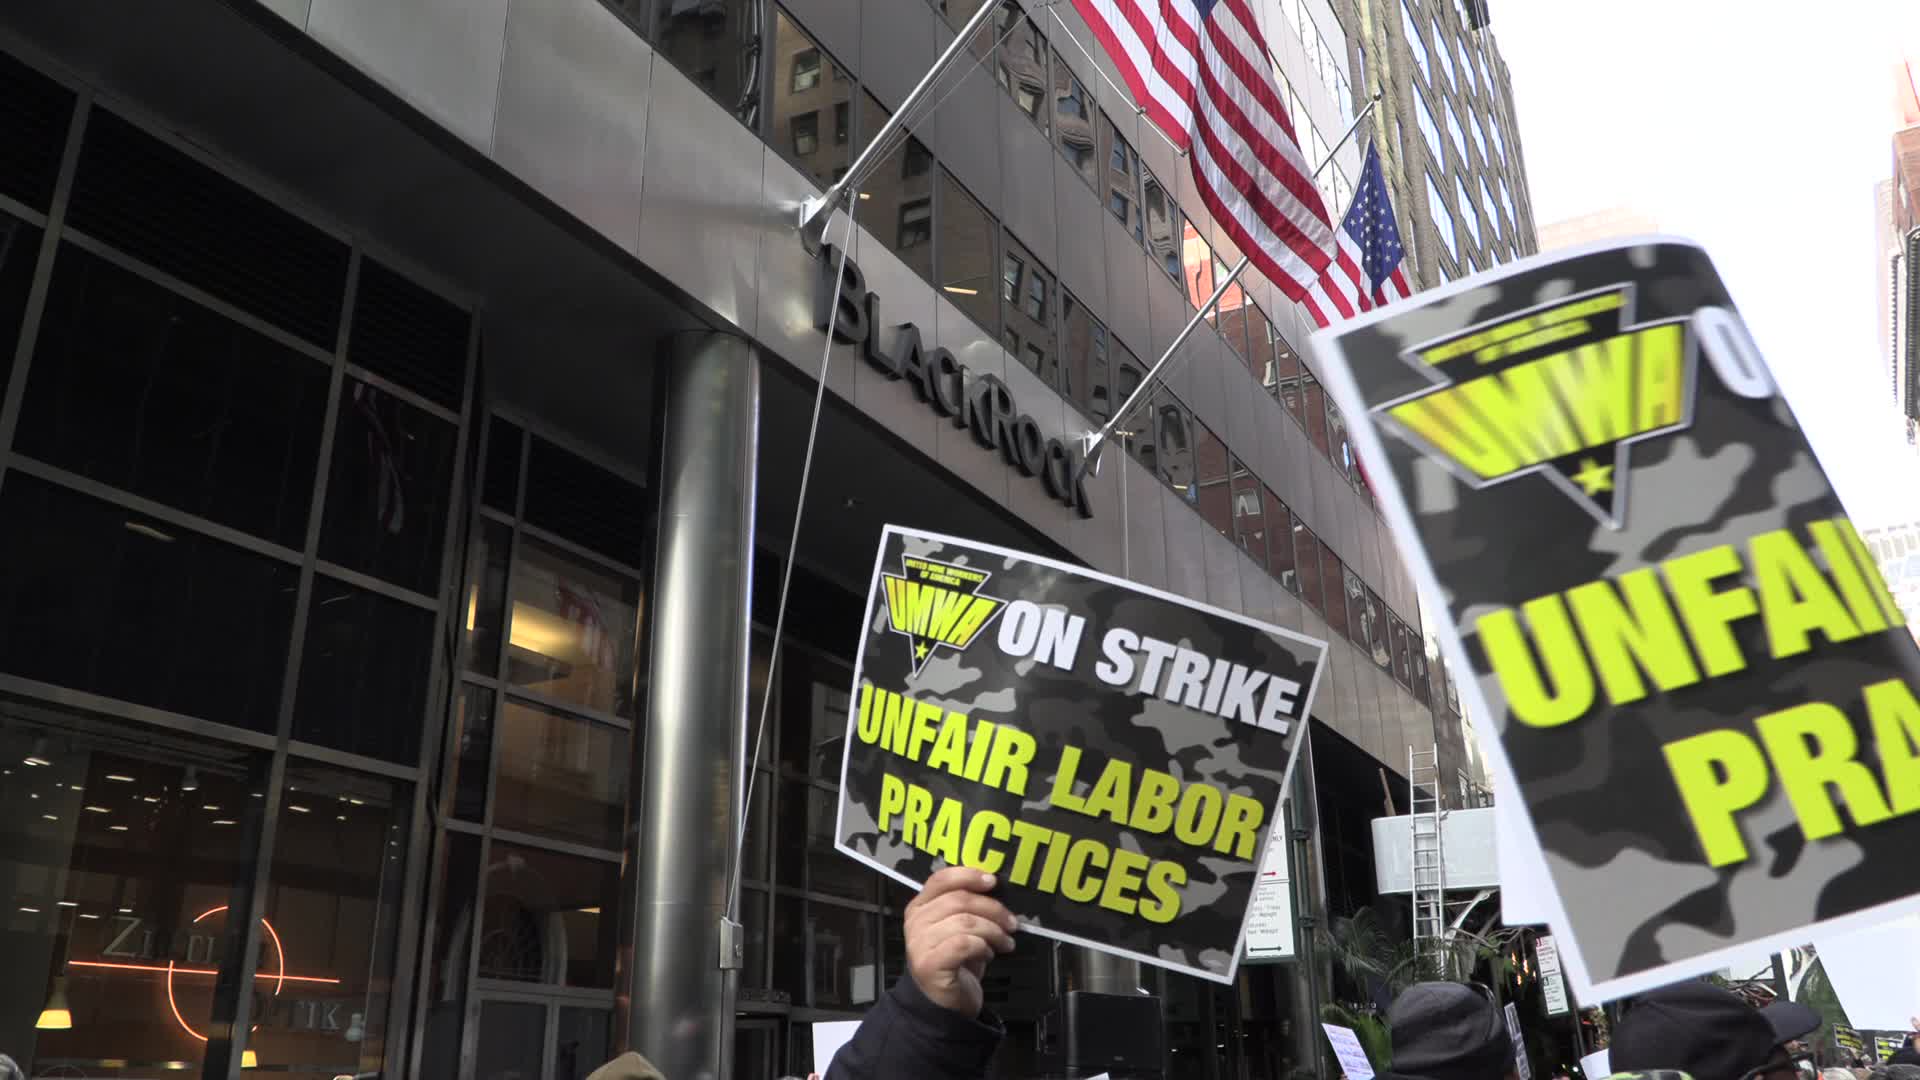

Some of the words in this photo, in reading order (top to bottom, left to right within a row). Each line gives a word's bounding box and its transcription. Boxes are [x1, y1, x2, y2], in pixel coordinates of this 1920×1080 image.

[1388, 323, 1684, 478] UMWA
[885, 576, 998, 646] UMWA
[997, 600, 1086, 671] ON
[1095, 628, 1301, 735] STRIKE
[856, 683, 1037, 796] UNFAIR
[1049, 744, 1264, 860] LABOR
[878, 773, 1187, 924] PRACTICES
